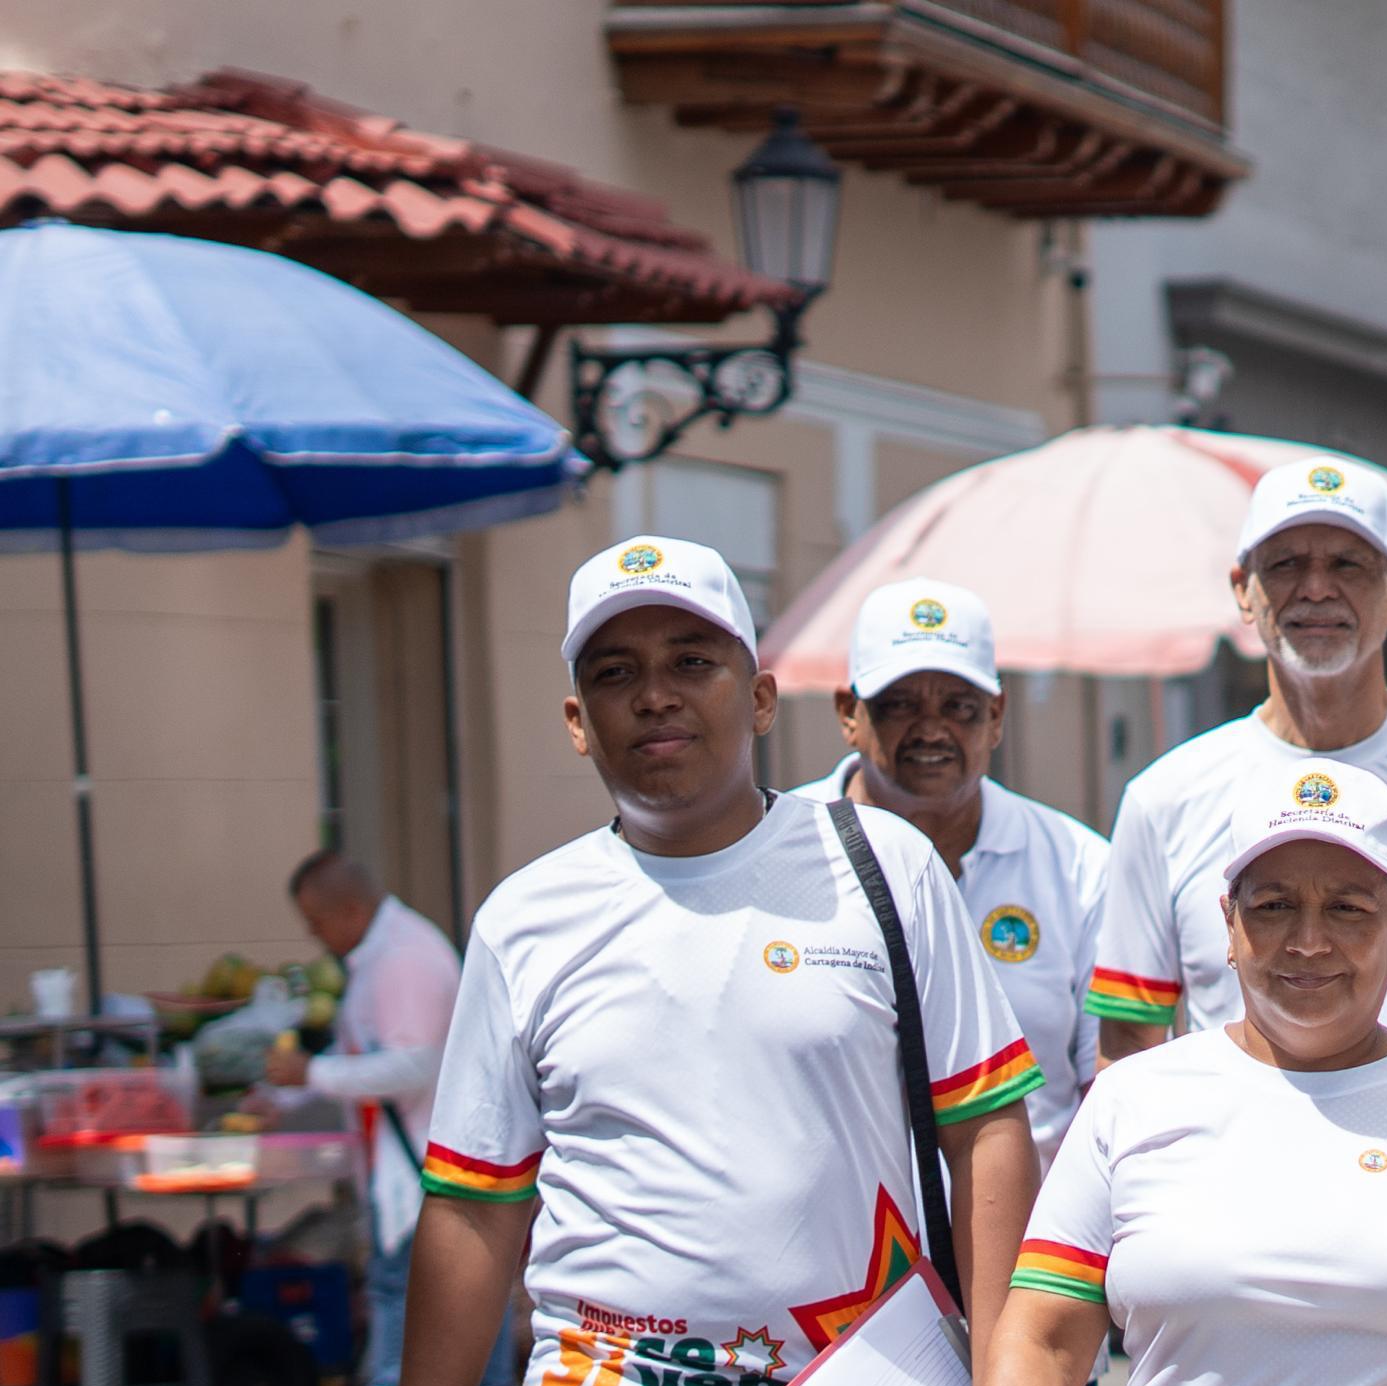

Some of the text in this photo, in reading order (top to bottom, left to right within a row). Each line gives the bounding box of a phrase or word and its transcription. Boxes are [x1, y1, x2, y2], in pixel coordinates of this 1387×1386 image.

[804, 945, 840, 955] Alcaldía
[842, 947, 868, 959] Mayor
[804, 958, 852, 968] Cartagena
[853, 960, 862, 968] de
[577, 1299, 688, 1335] Impuestos
